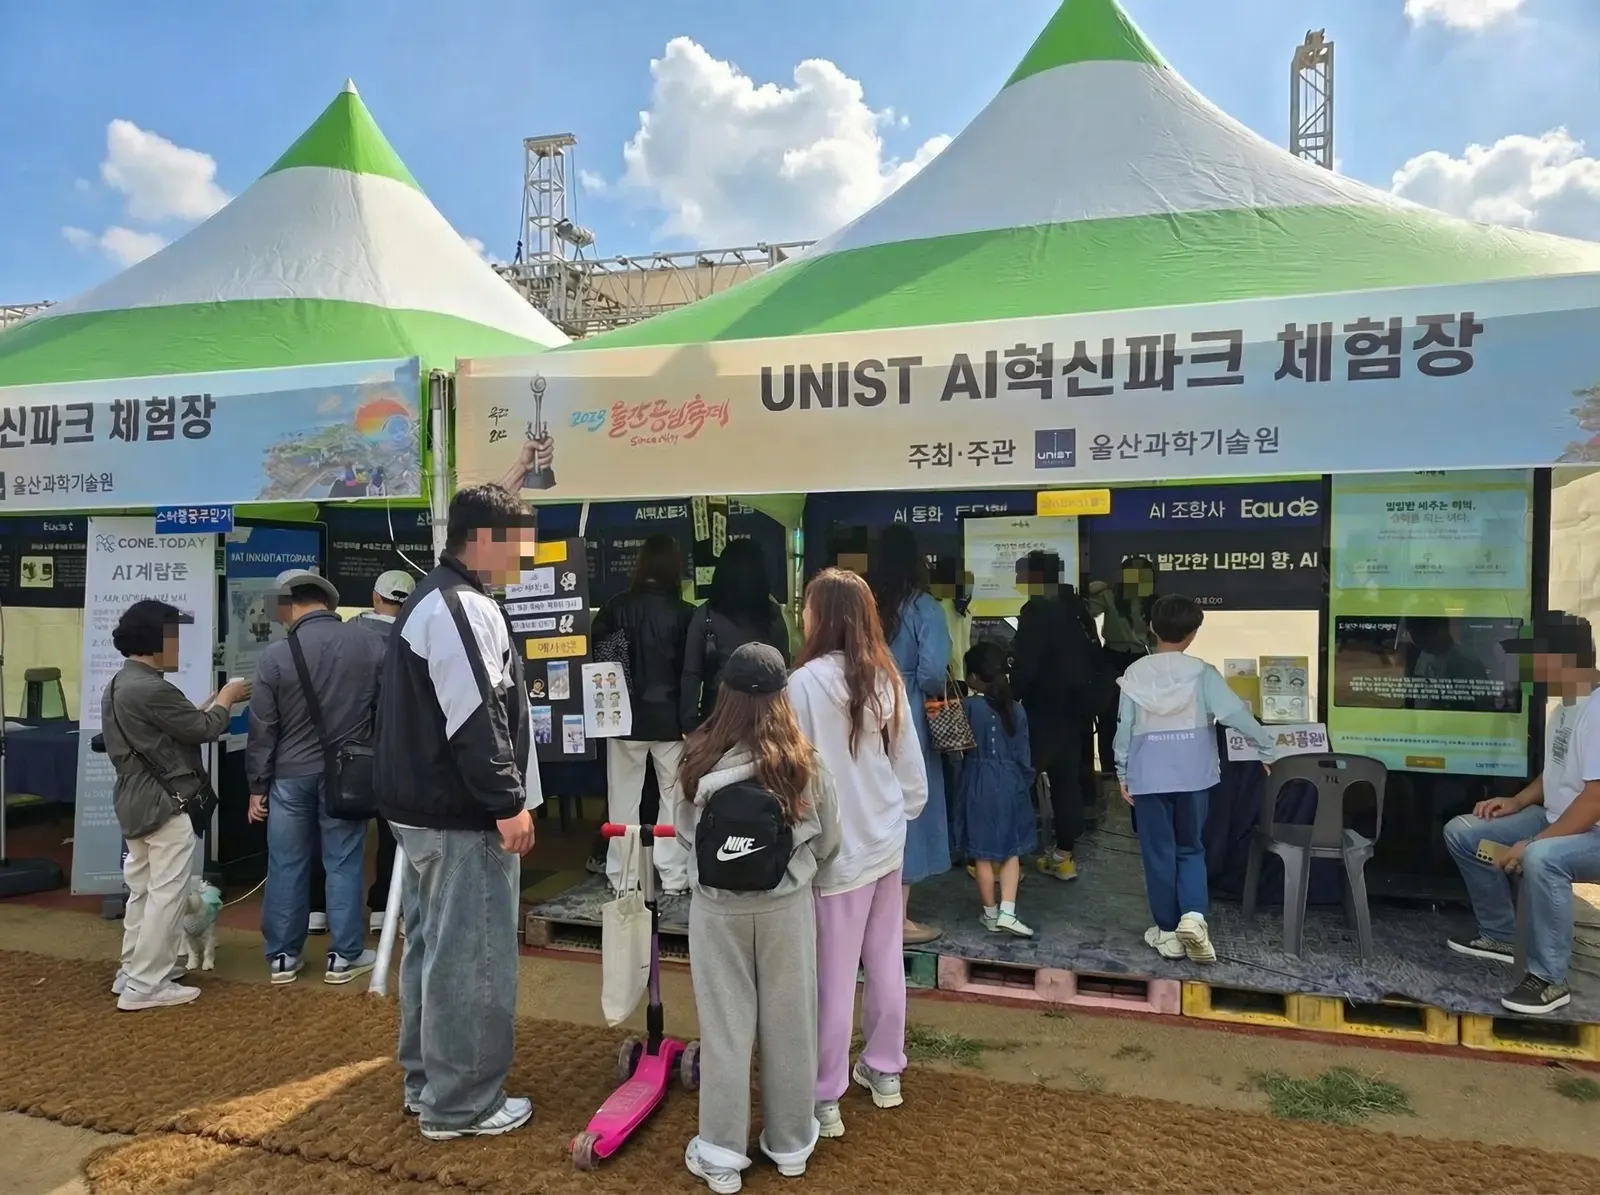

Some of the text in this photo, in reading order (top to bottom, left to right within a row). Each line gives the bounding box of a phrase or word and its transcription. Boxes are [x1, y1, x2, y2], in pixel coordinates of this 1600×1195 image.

[760, 310, 1485, 412] UNIST AI혁신파크 체험장
[109, 393, 217, 443] 체험장
[907, 426, 1281, 470] 주최·주관 울산과학기술원
[13, 472, 114, 496] 울산과학기술원
[894, 507, 907, 523] AI
[912, 505, 944, 523] 동화
[1149, 496, 1319, 519] AI 조향사 Eau de
[1157, 553, 1209, 572] 발간한
[1271, 551, 1295, 571] 향,
[1300, 552, 1318, 568] AI
[723, 835, 756, 852] NIKE
